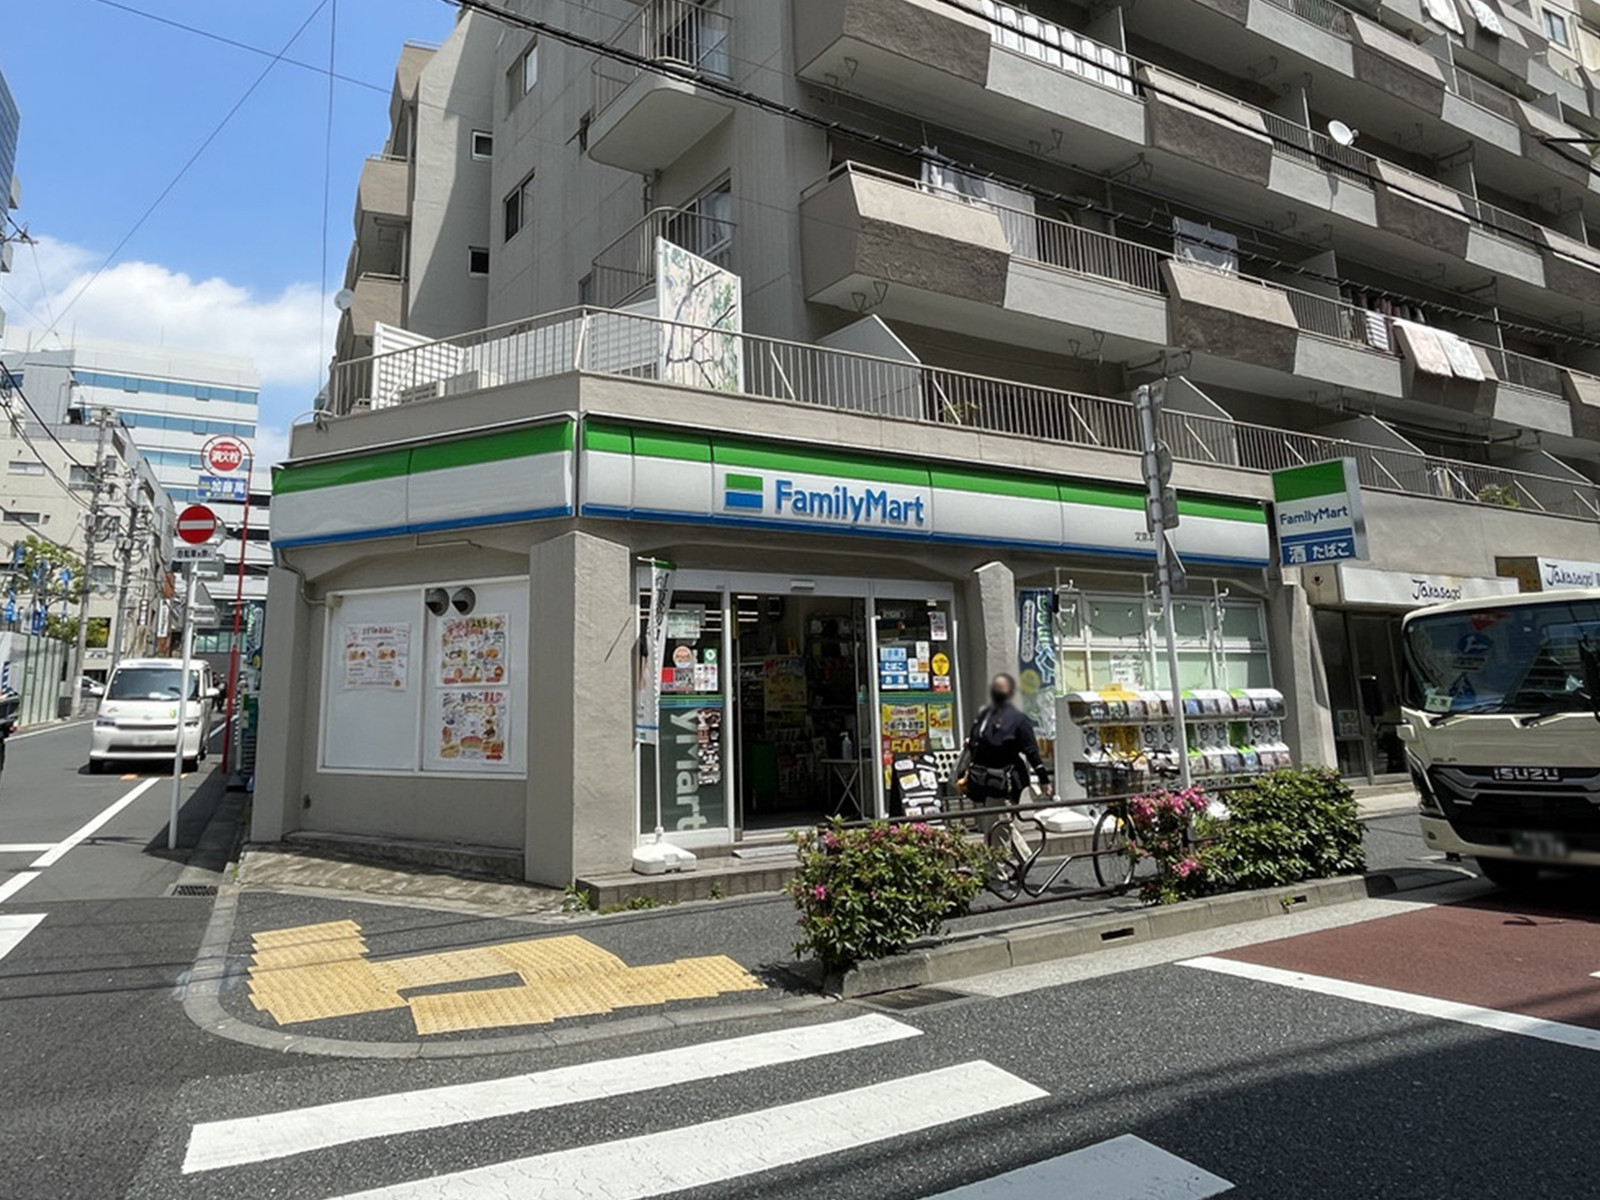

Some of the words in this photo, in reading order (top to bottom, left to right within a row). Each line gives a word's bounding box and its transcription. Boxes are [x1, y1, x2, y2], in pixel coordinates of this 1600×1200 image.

[211, 450, 240, 463] 消火栓
[775, 479, 924, 525] FamilyMart
[1280, 505, 1349, 525] FamilyMart
[1288, 545, 1307, 563] 酒
[1312, 542, 1350, 559] たばこ
[1493, 767, 1560, 781] ISUZU
